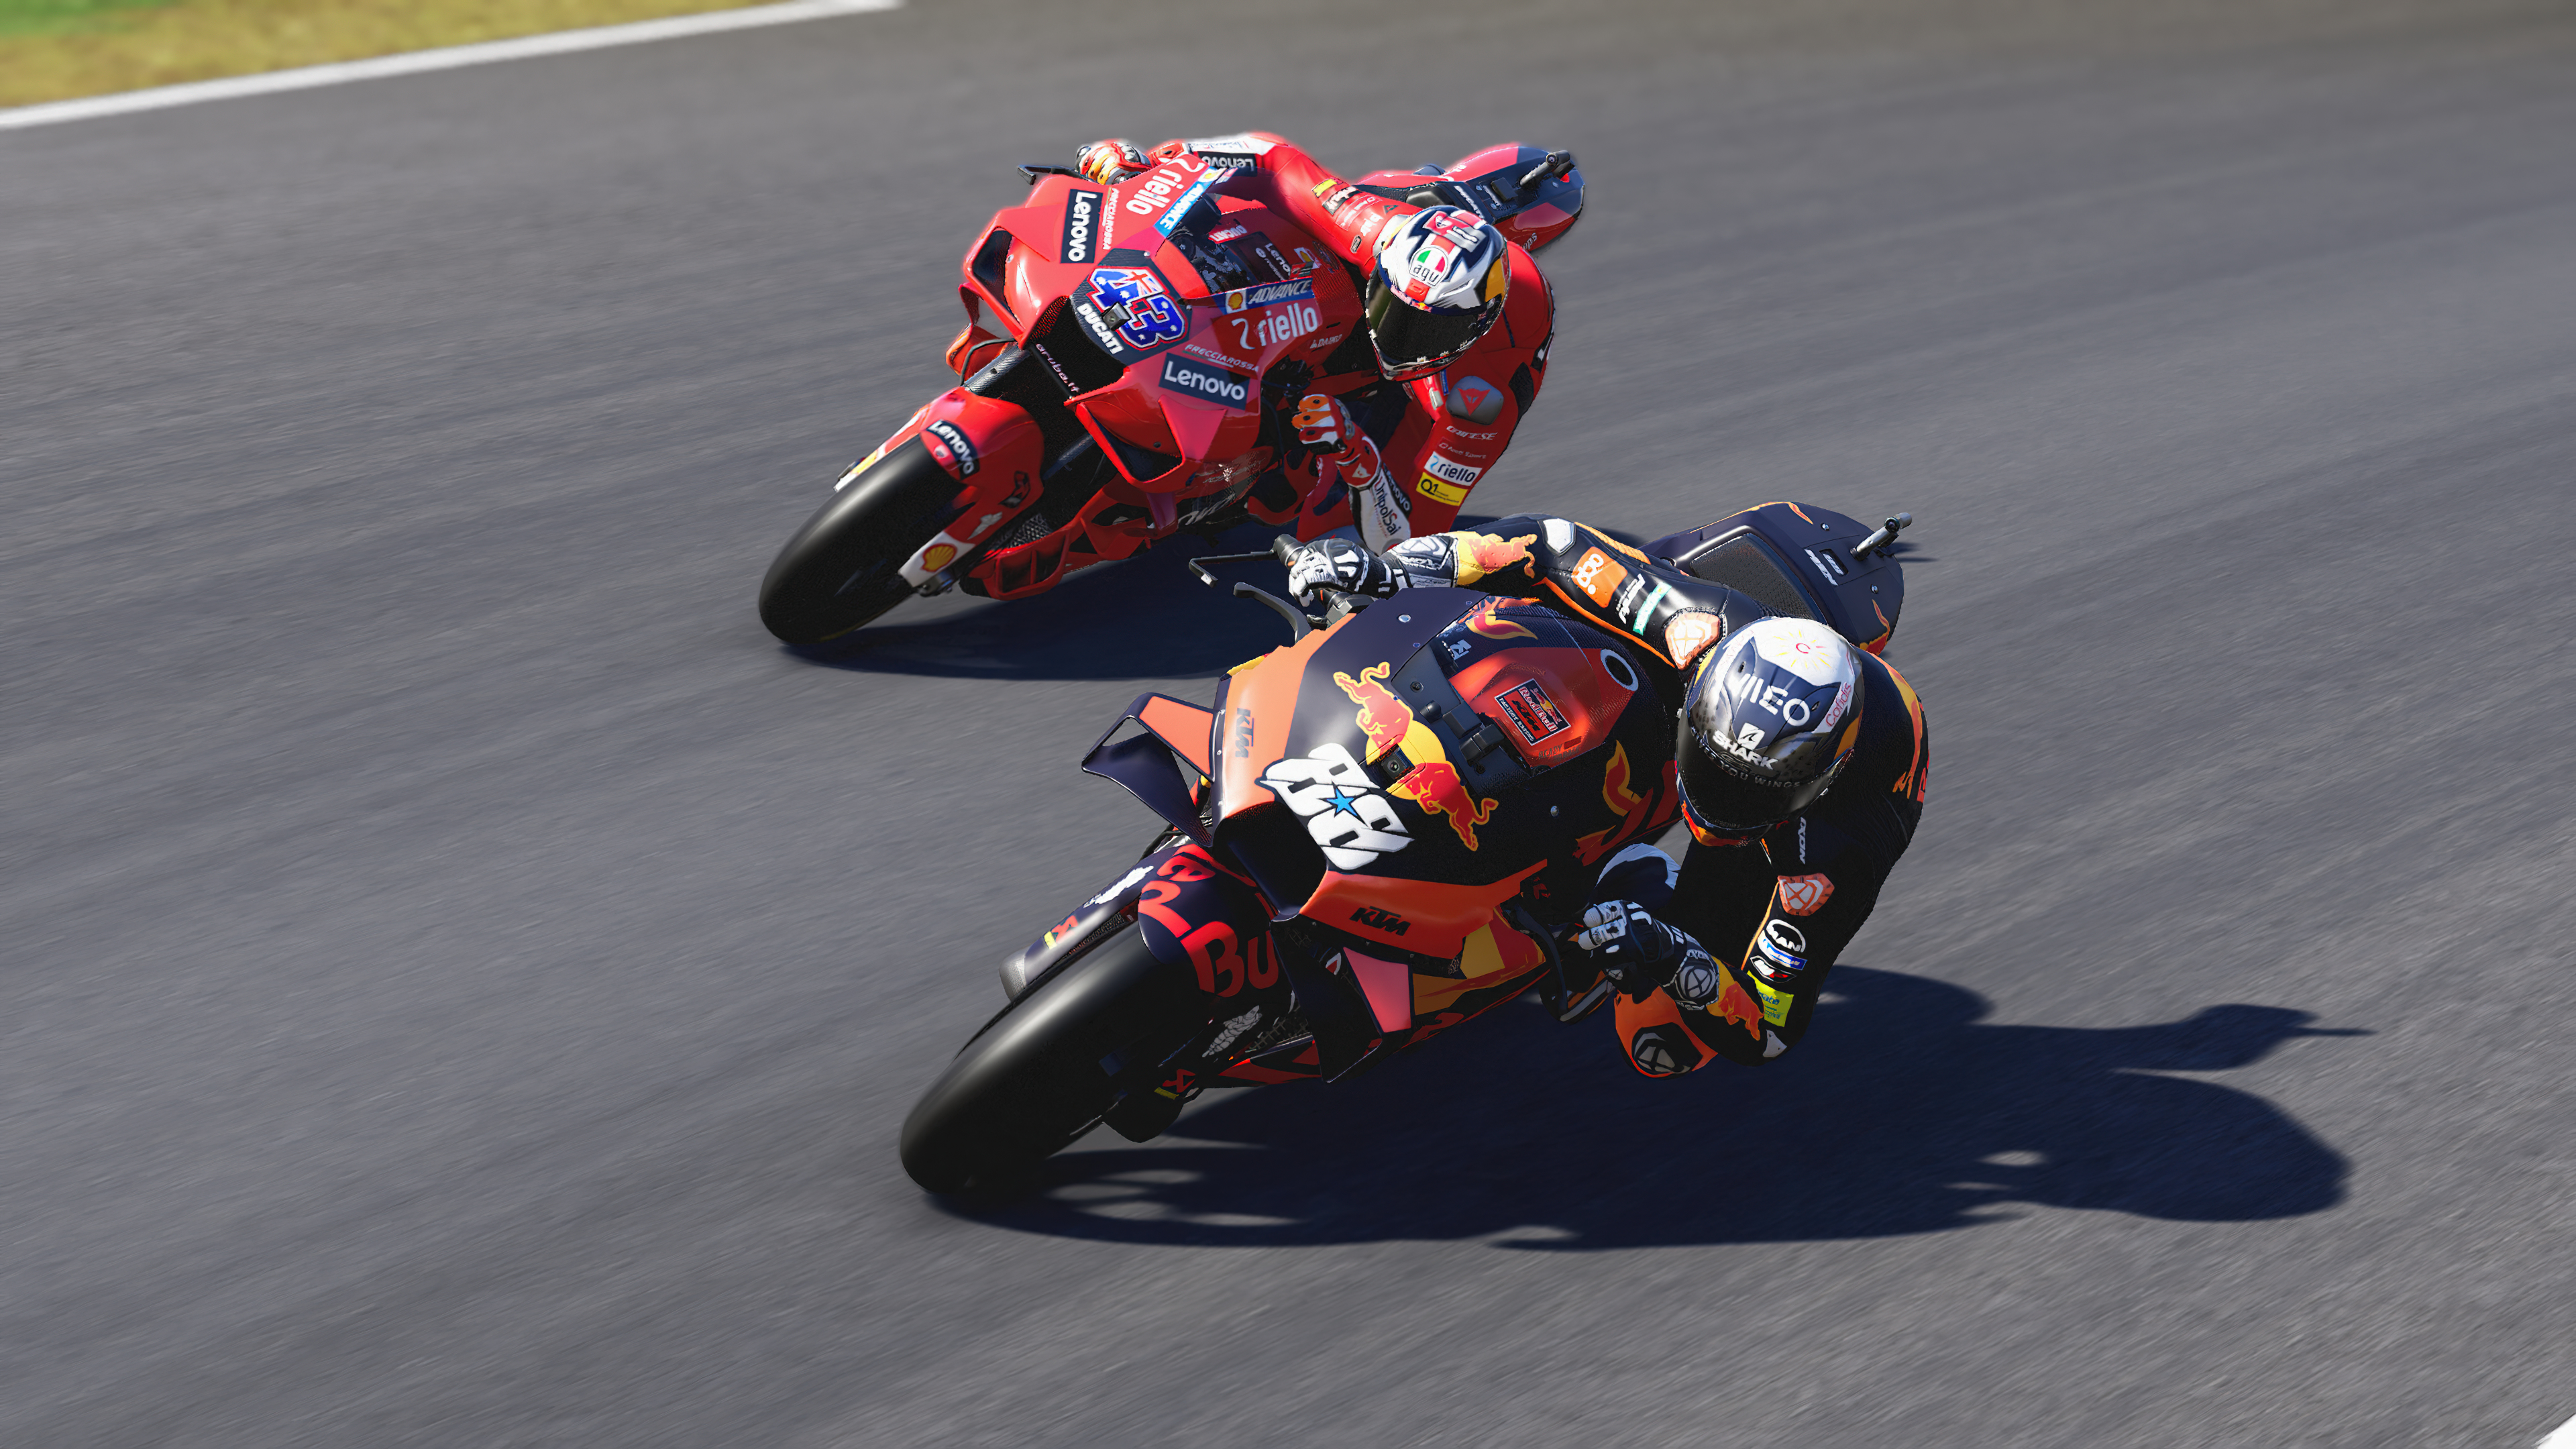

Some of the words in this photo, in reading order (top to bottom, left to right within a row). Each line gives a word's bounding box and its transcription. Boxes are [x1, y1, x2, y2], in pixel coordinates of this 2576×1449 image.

[1201, 155, 1254, 172] Lenovo
[1126, 167, 1185, 215] riello
[1068, 191, 1098, 262] Lenovo
[1086, 265, 1188, 352] 43
[1248, 279, 1312, 305] ADVANCE
[1077, 303, 1124, 355] DUCATI
[1253, 303, 1319, 347] riello
[1035, 343, 1080, 392] aruba.it
[1163, 360, 1246, 400] Lenovo
[1185, 343, 1259, 373] FRECCIAROSSA
[928, 420, 975, 475] Lenovo
[1437, 462, 1476, 483] riello
[1373, 475, 1401, 536] UnipolSai
[1234, 707, 1254, 758] KTM
[1712, 729, 1778, 770] SHARK
[1257, 741, 1415, 871] 88
[1348, 906, 1411, 936] KTM
[1766, 926, 1803, 952] MAN
